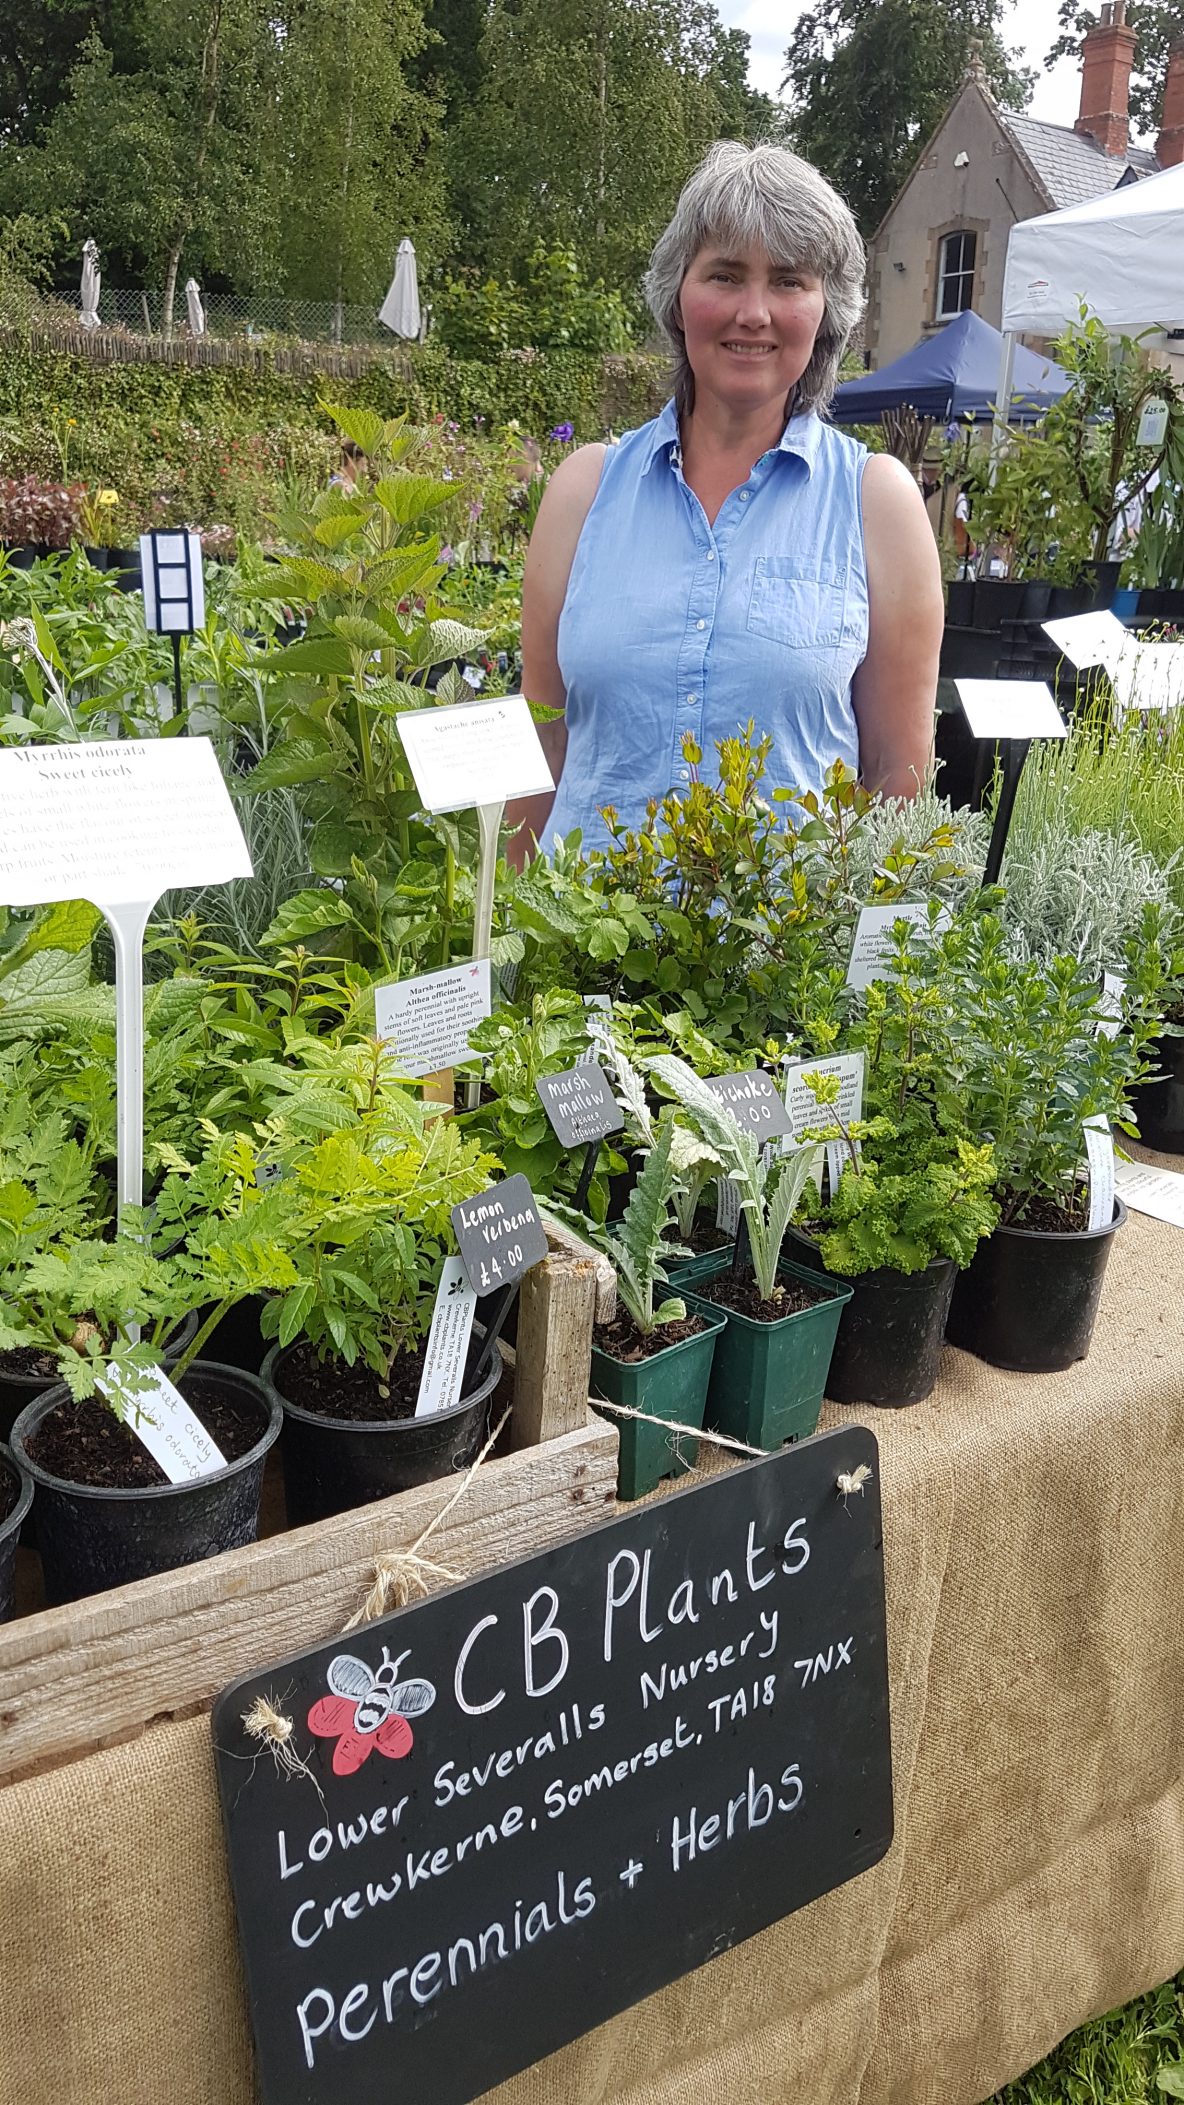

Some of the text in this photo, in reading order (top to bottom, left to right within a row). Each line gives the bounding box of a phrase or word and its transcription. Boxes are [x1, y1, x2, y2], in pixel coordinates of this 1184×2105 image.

[13, 746, 147, 765] Myrrhis odorata
[38, 763, 133, 782] Sweet cicely
[405, 986, 467, 1007] Althea officinalis
[409, 977, 462, 996] Marsh-mallow
[384, 998, 484, 1031] stems of soft leaves and pale pink
[395, 1008, 412, 1019] hardy
[414, 1002, 442, 1014] perennial
[443, 997, 457, 1005] with
[458, 991, 480, 1002] upright
[421, 1028, 436, 1038] used
[436, 1025, 446, 1033] for
[446, 1021, 461, 1031] their
[423, 1017, 444, 1029] Leaves
[445, 1014, 457, 1022] and
[457, 1010, 473, 1019] roots
[399, 1033, 452, 1054] anti-inflammatory
[430, 1040, 459, 1054] originally
[548, 1072, 591, 1099] Marsh
[713, 1075, 772, 1104] tichoke
[559, 1090, 604, 1118] Mallow
[808, 1108, 818, 1116] and
[460, 1201, 504, 1229] Lemon
[456, 1333, 465, 1354] Lower
[445, 1384, 456, 1409] Nurser
[185, 1423, 211, 1463] cicely
[603, 1517, 810, 1662] Plants
[708, 1674, 776, 1733] TA18
[794, 1637, 858, 1688] 7NX
[278, 1610, 779, 1879] Lower Severalls Nursery
[671, 1763, 804, 1872] Herbs
